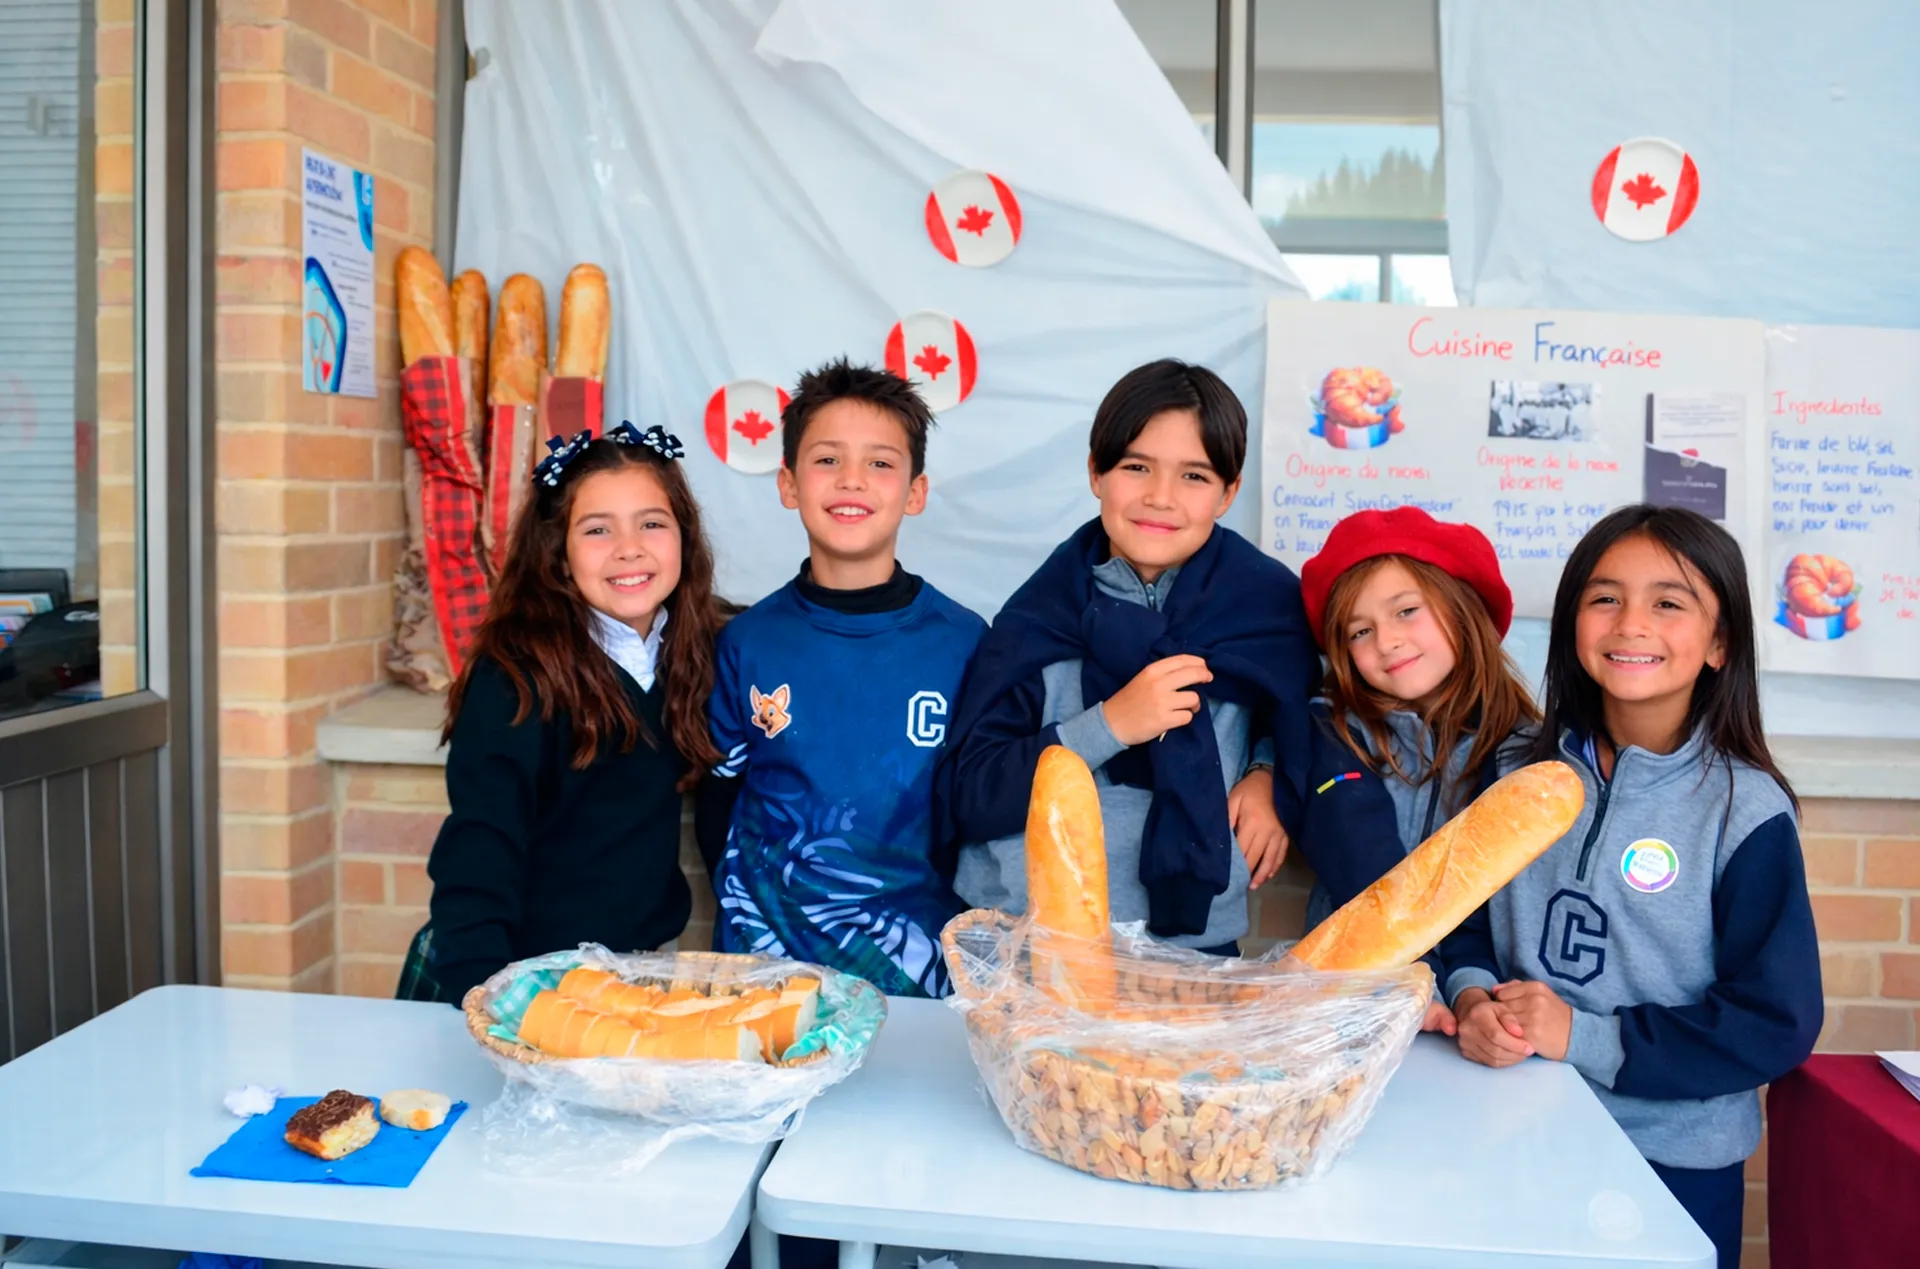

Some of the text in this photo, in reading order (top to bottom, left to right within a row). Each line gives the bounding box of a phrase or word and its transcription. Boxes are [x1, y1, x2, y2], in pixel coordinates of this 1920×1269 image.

[1408, 316, 1662, 369] Cuisine Française
[1285, 453, 1352, 488] Origine
[1818, 436, 1841, 452] de
[907, 691, 947, 747] C
[1538, 888, 1608, 987] C
